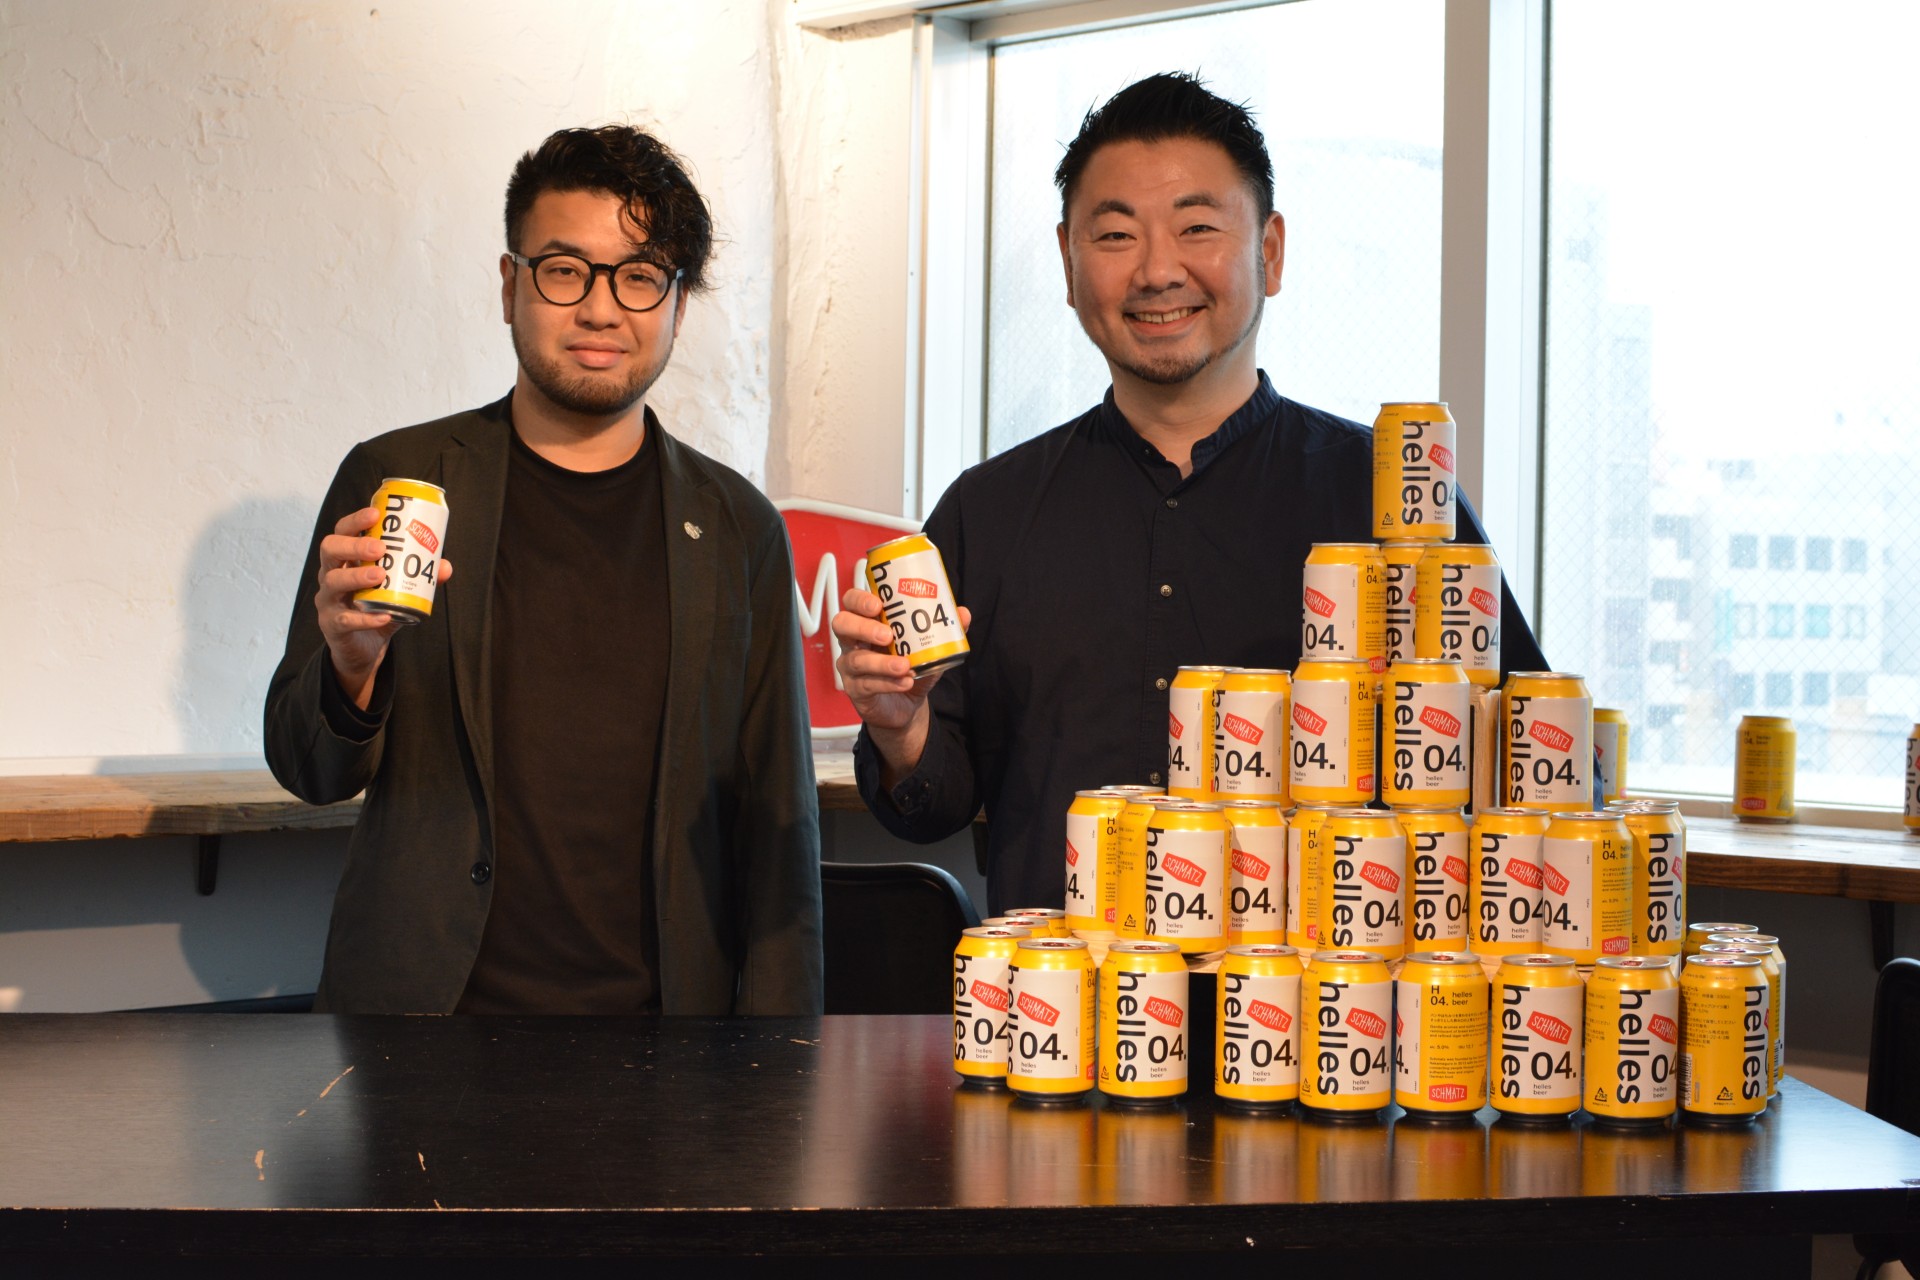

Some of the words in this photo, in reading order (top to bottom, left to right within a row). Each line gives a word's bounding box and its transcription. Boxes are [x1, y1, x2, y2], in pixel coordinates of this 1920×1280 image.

[1401, 421, 1430, 525] helles
[408, 522, 437, 551] SCHMATZ
[403, 553, 435, 586] 04.
[1366, 565, 1373, 573] H
[900, 580, 936, 597] SCHMATZ
[870, 560, 911, 657] helles
[911, 603, 955, 634] 04.
[1305, 623, 1344, 650] 04.
[1358, 681, 1365, 690] H
[1358, 691, 1371, 700] 04.
[1225, 716, 1262, 742] SCHMATZ
[1294, 706, 1324, 733] SCHMATZ
[1423, 709, 1459, 736] SCHMATZ
[1393, 681, 1422, 791] helles
[1510, 696, 1532, 803] helles
[1532, 725, 1571, 751] SCHMATZ
[1225, 750, 1271, 778] 04.
[1294, 741, 1336, 770] 04.
[1423, 745, 1466, 773] 04.
[1532, 758, 1581, 786] 04.
[1107, 817, 1115, 825] H
[1308, 830, 1316, 838] H
[1602, 840, 1610, 849] H
[1602, 850, 1618, 860] 04.
[1165, 856, 1203, 884] SCHMATZ
[1232, 852, 1267, 879] SCHMATZ
[1364, 865, 1398, 892] SCHMATZ
[1145, 827, 1164, 936] helles
[1332, 836, 1363, 947] helles
[1413, 832, 1444, 941] helles
[1479, 832, 1507, 943] helles
[1647, 833, 1675, 943] helles
[1164, 892, 1213, 921] 04.
[1231, 886, 1276, 914] 04.
[1363, 899, 1403, 929] 04.
[1543, 900, 1578, 931] 04.
[1430, 995, 1449, 1006] 04.
[1431, 985, 1440, 994] H
[954, 953, 972, 1061] helles
[1019, 994, 1056, 1023] SCHMATZ
[1148, 1001, 1182, 1025] SCHMATZ
[1251, 1003, 1289, 1029] SCHMATZ
[1115, 970, 1146, 1083] helles
[1222, 973, 1250, 1085] helles
[1317, 981, 1349, 1095] helles
[1350, 1012, 1384, 1037] SCHMATZ
[1531, 1014, 1569, 1042] SCHMATZ
[1019, 1031, 1068, 1061] 04.
[1148, 1033, 1186, 1063] 04.
[1250, 1039, 1298, 1068] 04.
[1500, 983, 1530, 1098] helles
[1616, 989, 1651, 1104] helles
[1742, 985, 1767, 1101] helles
[1350, 1046, 1389, 1076] 04.
[1531, 1051, 1576, 1081] 04.
[1431, 1086, 1465, 1100] SCHMATZ
